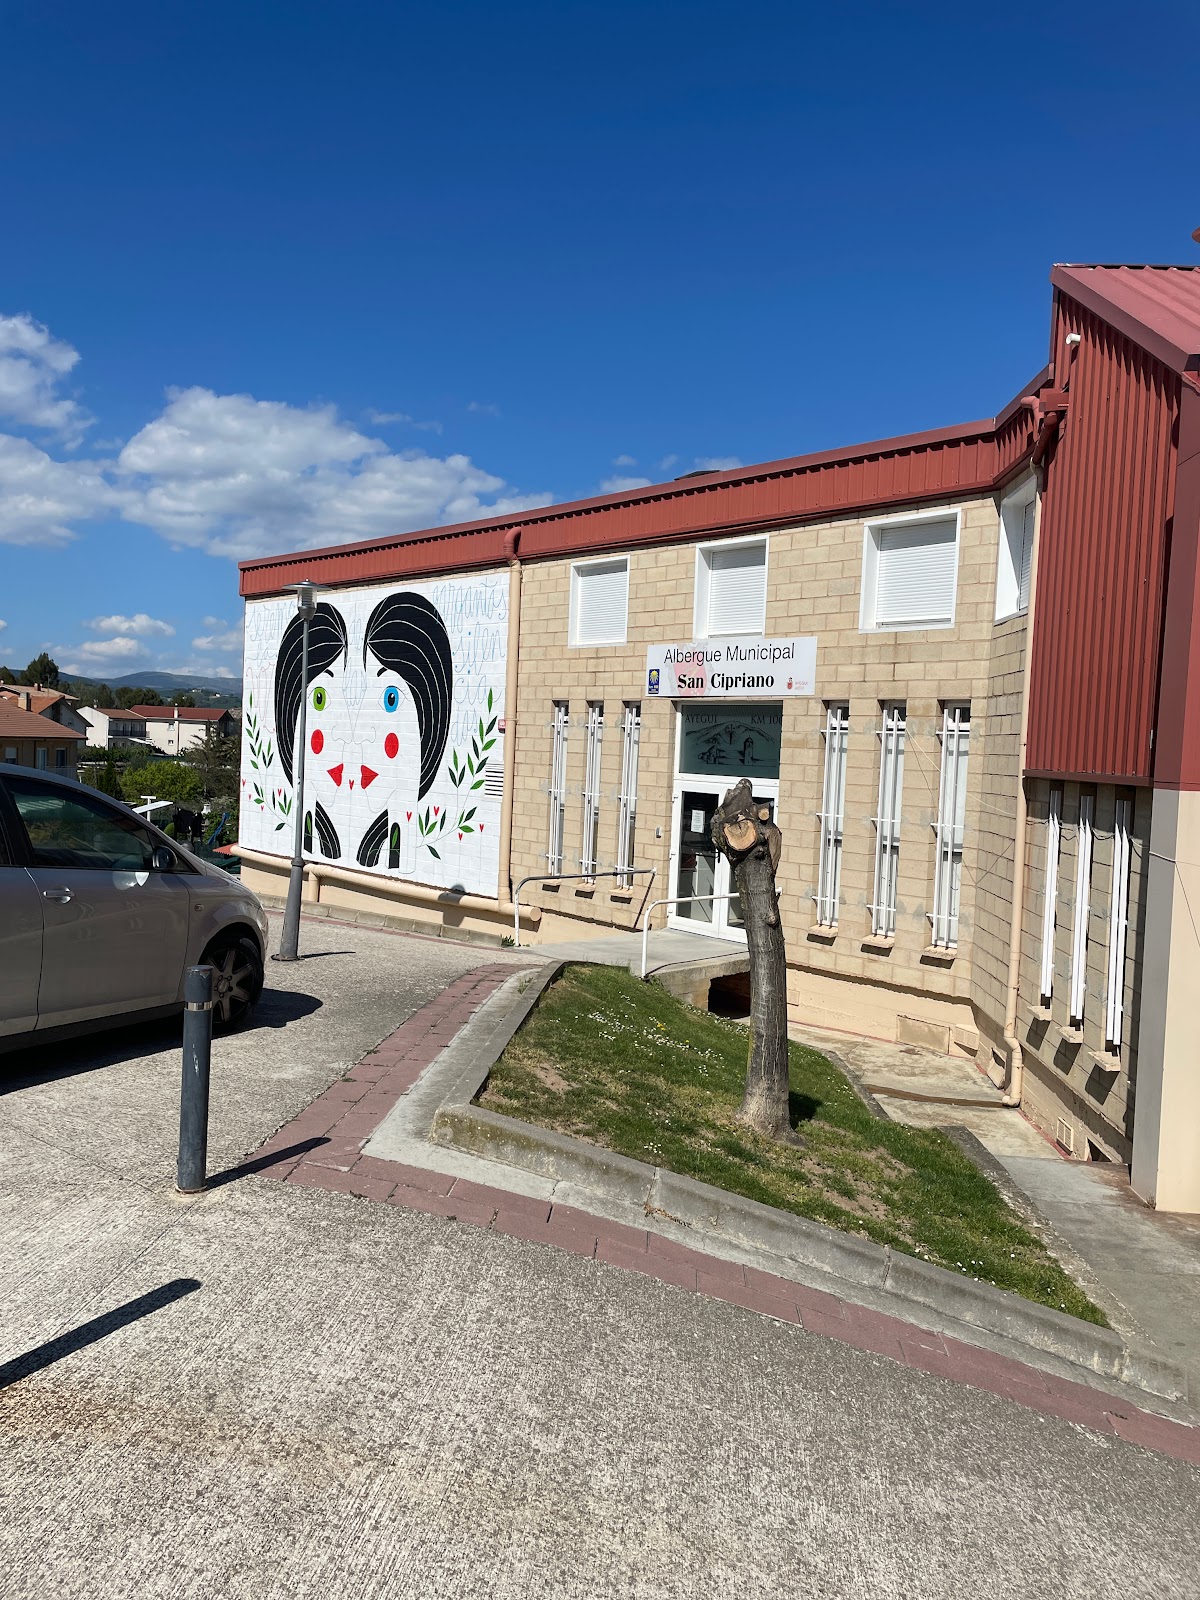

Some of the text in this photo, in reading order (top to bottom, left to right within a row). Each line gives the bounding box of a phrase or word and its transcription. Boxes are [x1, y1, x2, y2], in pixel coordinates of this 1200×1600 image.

[664, 643, 795, 666] Albergue Municipal
[677, 673, 704, 689] San
[710, 672, 775, 690] Cipriano
[685, 713, 718, 724] AYEGUI
[751, 714, 766, 724] KM
